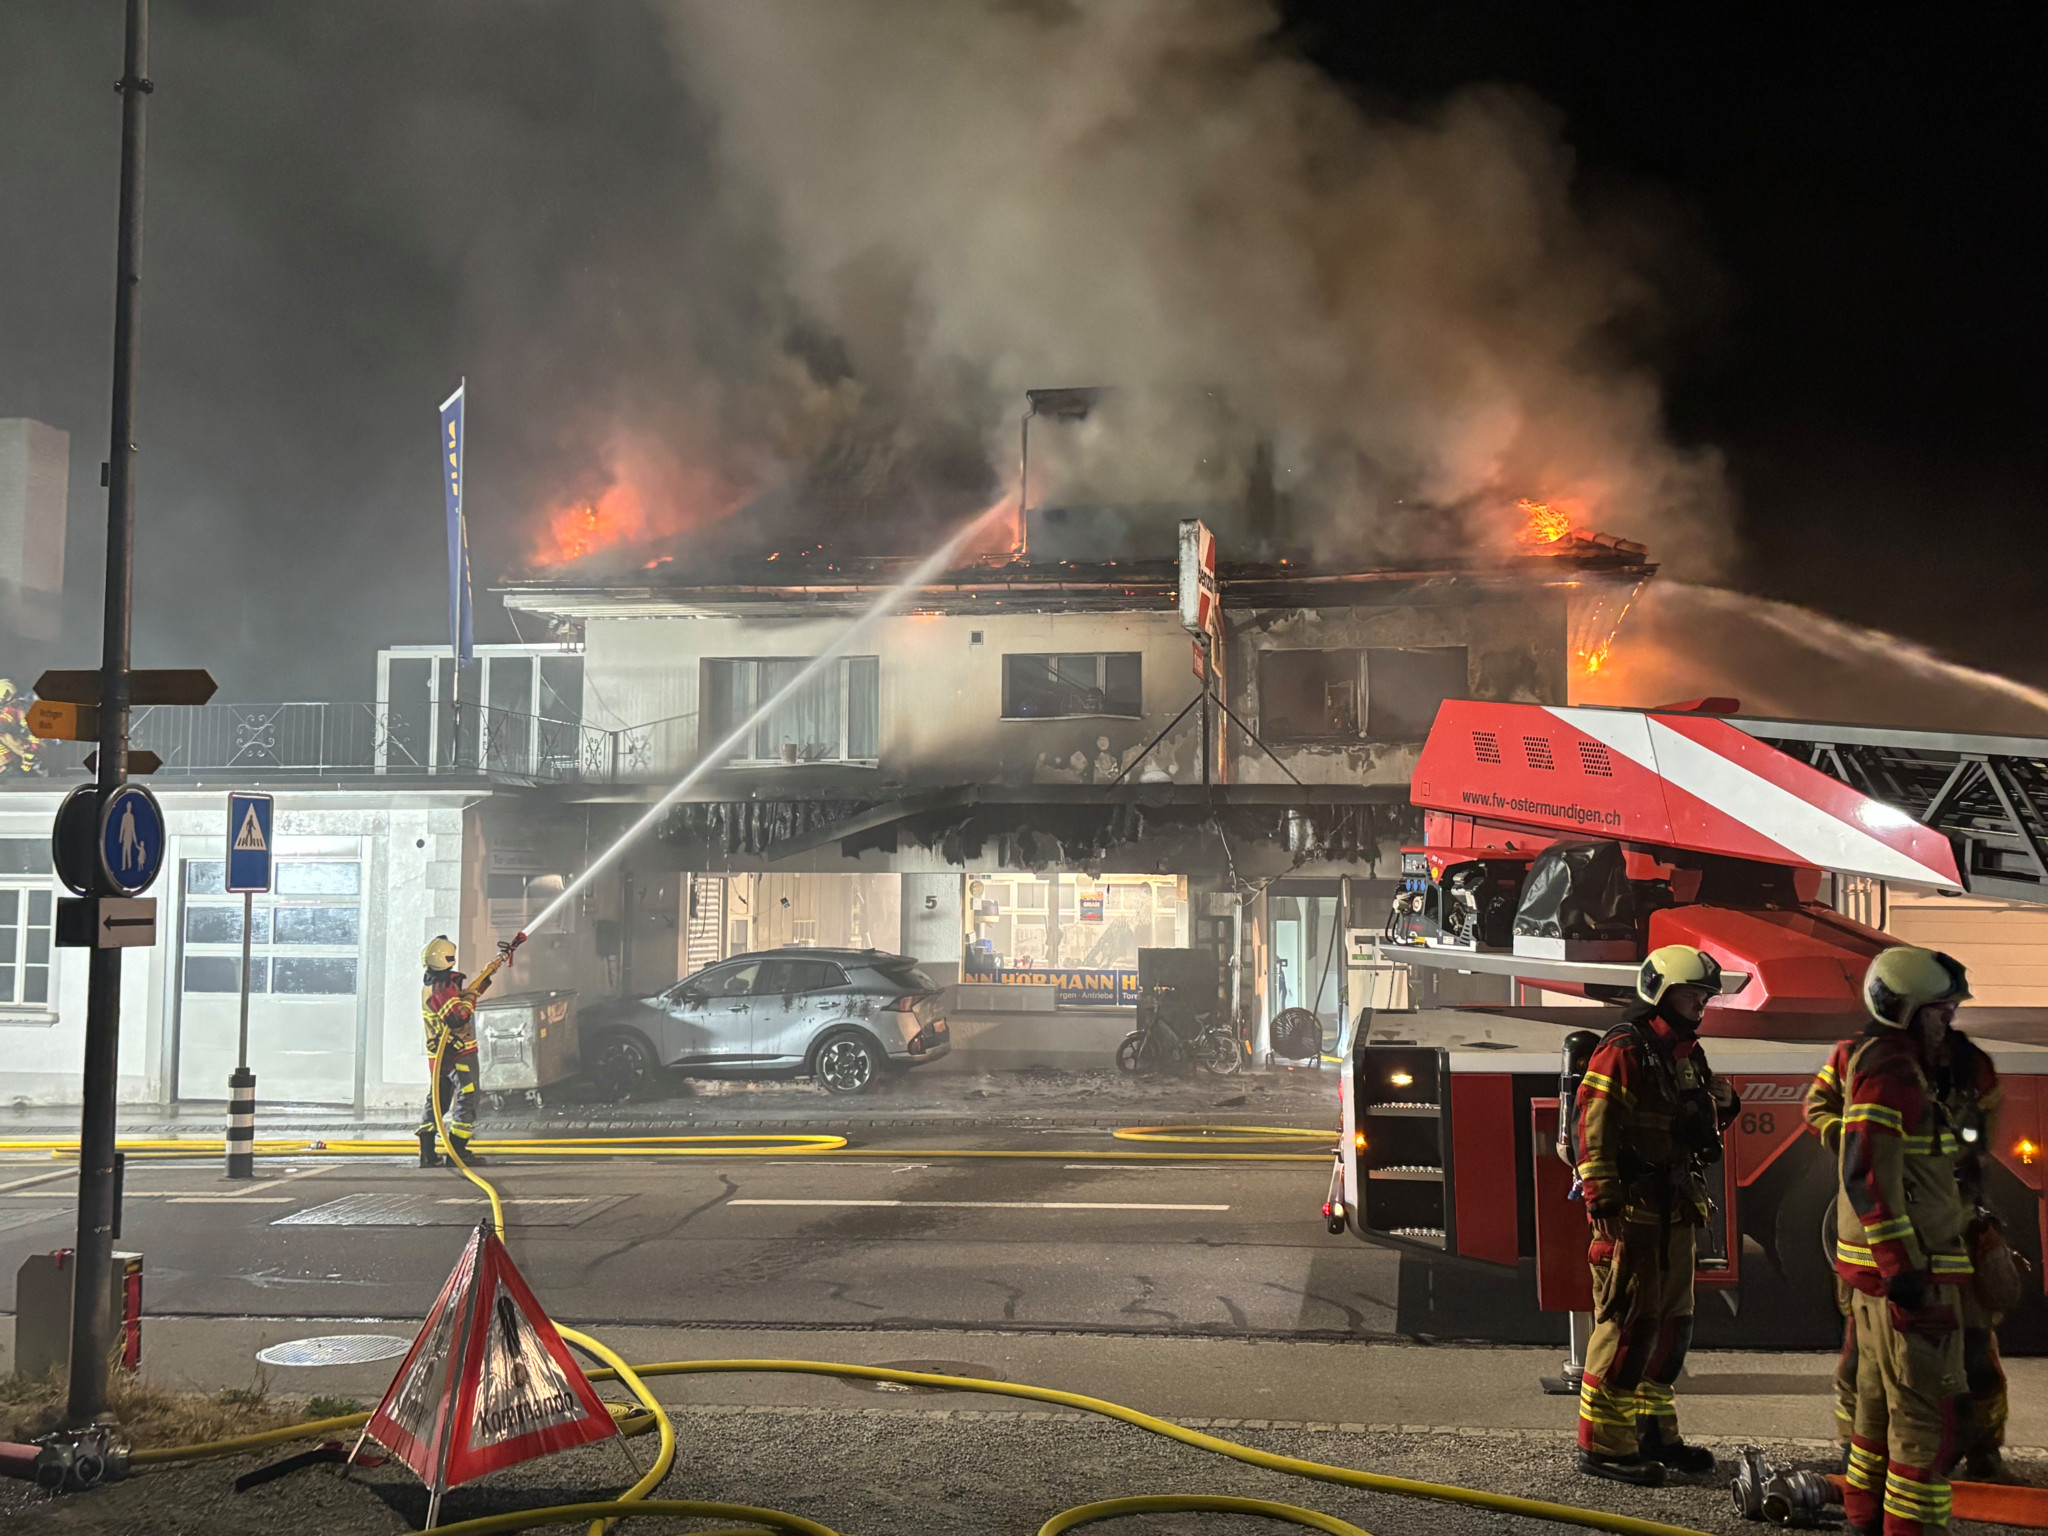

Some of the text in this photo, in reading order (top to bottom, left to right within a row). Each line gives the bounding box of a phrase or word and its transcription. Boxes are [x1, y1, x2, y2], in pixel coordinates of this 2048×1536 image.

[1462, 791, 1621, 826] www.fw-ostermundigen.ch
[924, 895, 938, 910] 5
[1081, 991, 1114, 1000] Antriebe
[1741, 1112, 1775, 1135] 68
